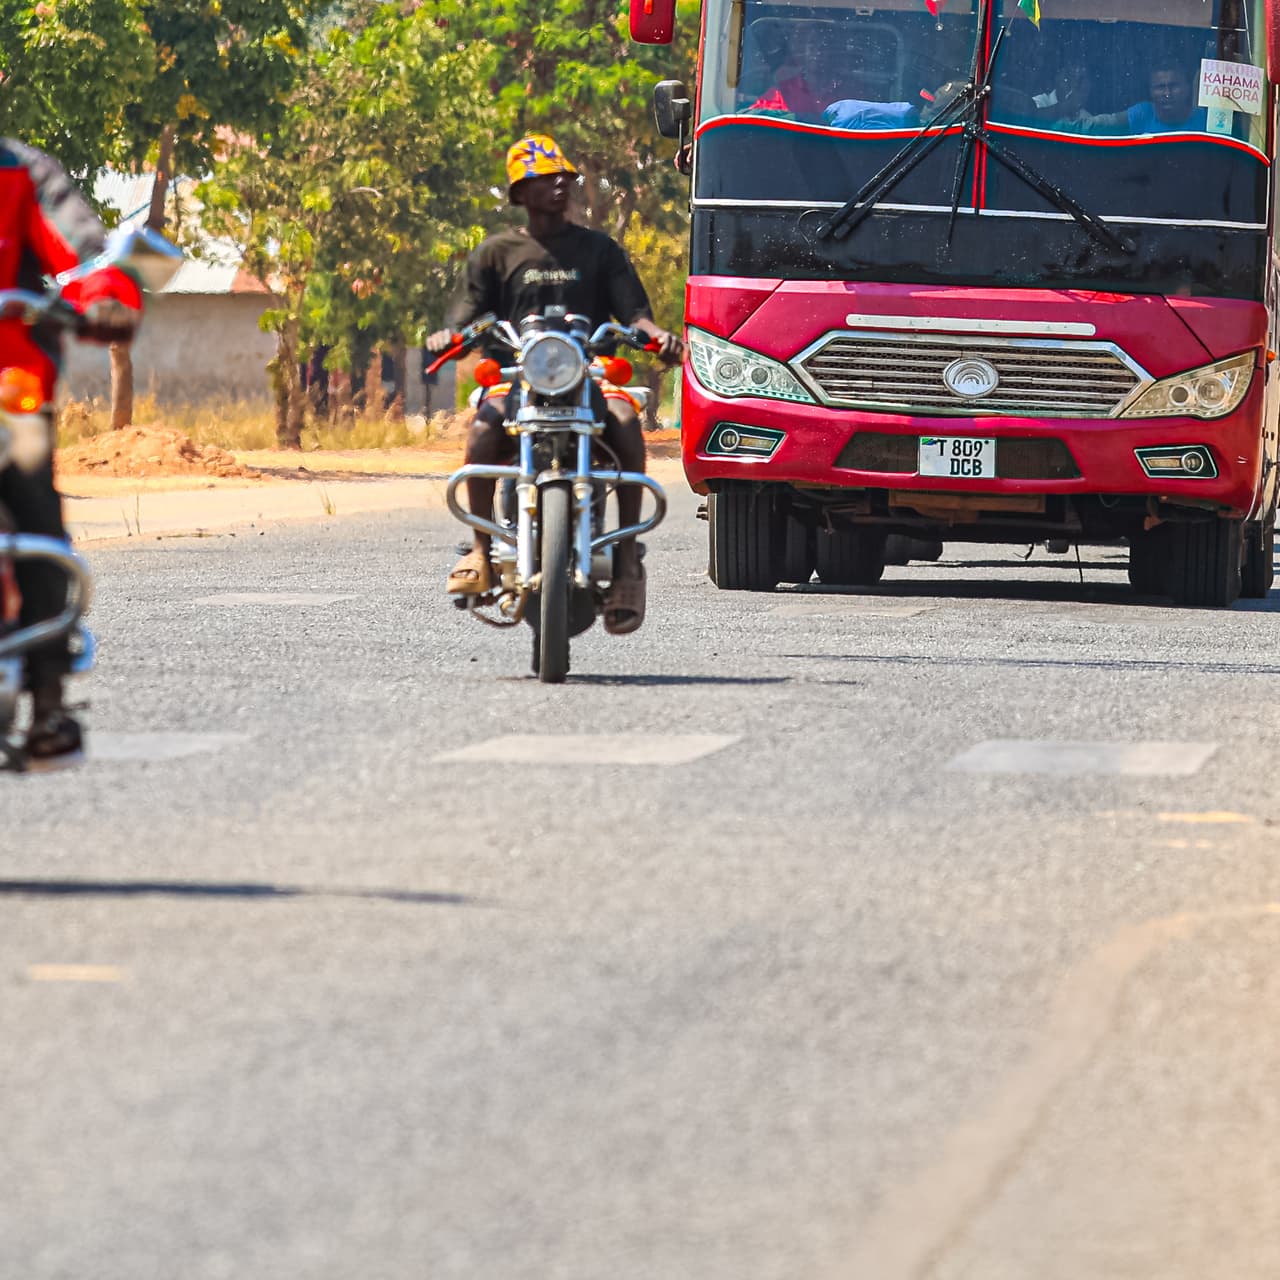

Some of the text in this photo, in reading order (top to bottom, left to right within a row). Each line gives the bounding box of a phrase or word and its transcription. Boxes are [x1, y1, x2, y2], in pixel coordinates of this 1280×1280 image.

[1204, 73, 1260, 90] KAHAMA
[1204, 85, 1259, 102] TABORA
[937, 439, 983, 457] T 809
[950, 458, 982, 476] DCB
